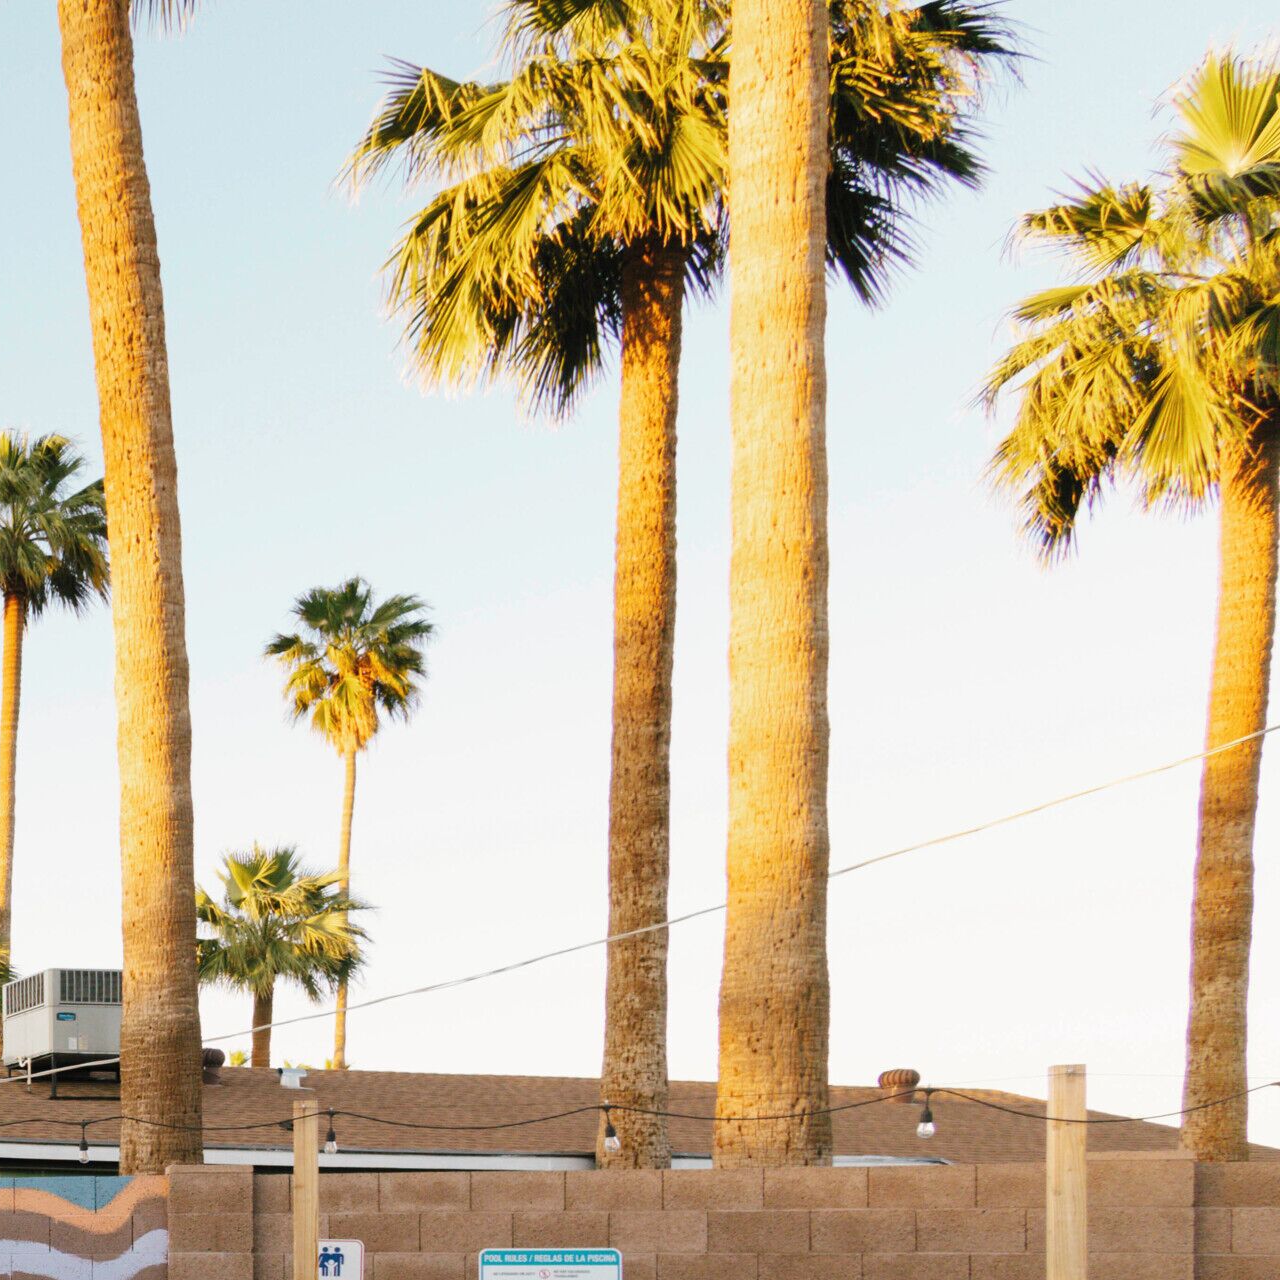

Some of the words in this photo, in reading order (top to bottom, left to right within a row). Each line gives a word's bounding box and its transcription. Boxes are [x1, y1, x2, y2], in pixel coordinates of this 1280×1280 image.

[484, 1254, 503, 1262] POOL
[505, 1254, 528, 1262] RULES
[534, 1254, 562, 1262] REGLAS
[564, 1254, 574, 1262] DE
[576, 1254, 586, 1262] LA
[587, 1254, 616, 1262] PISCINA
